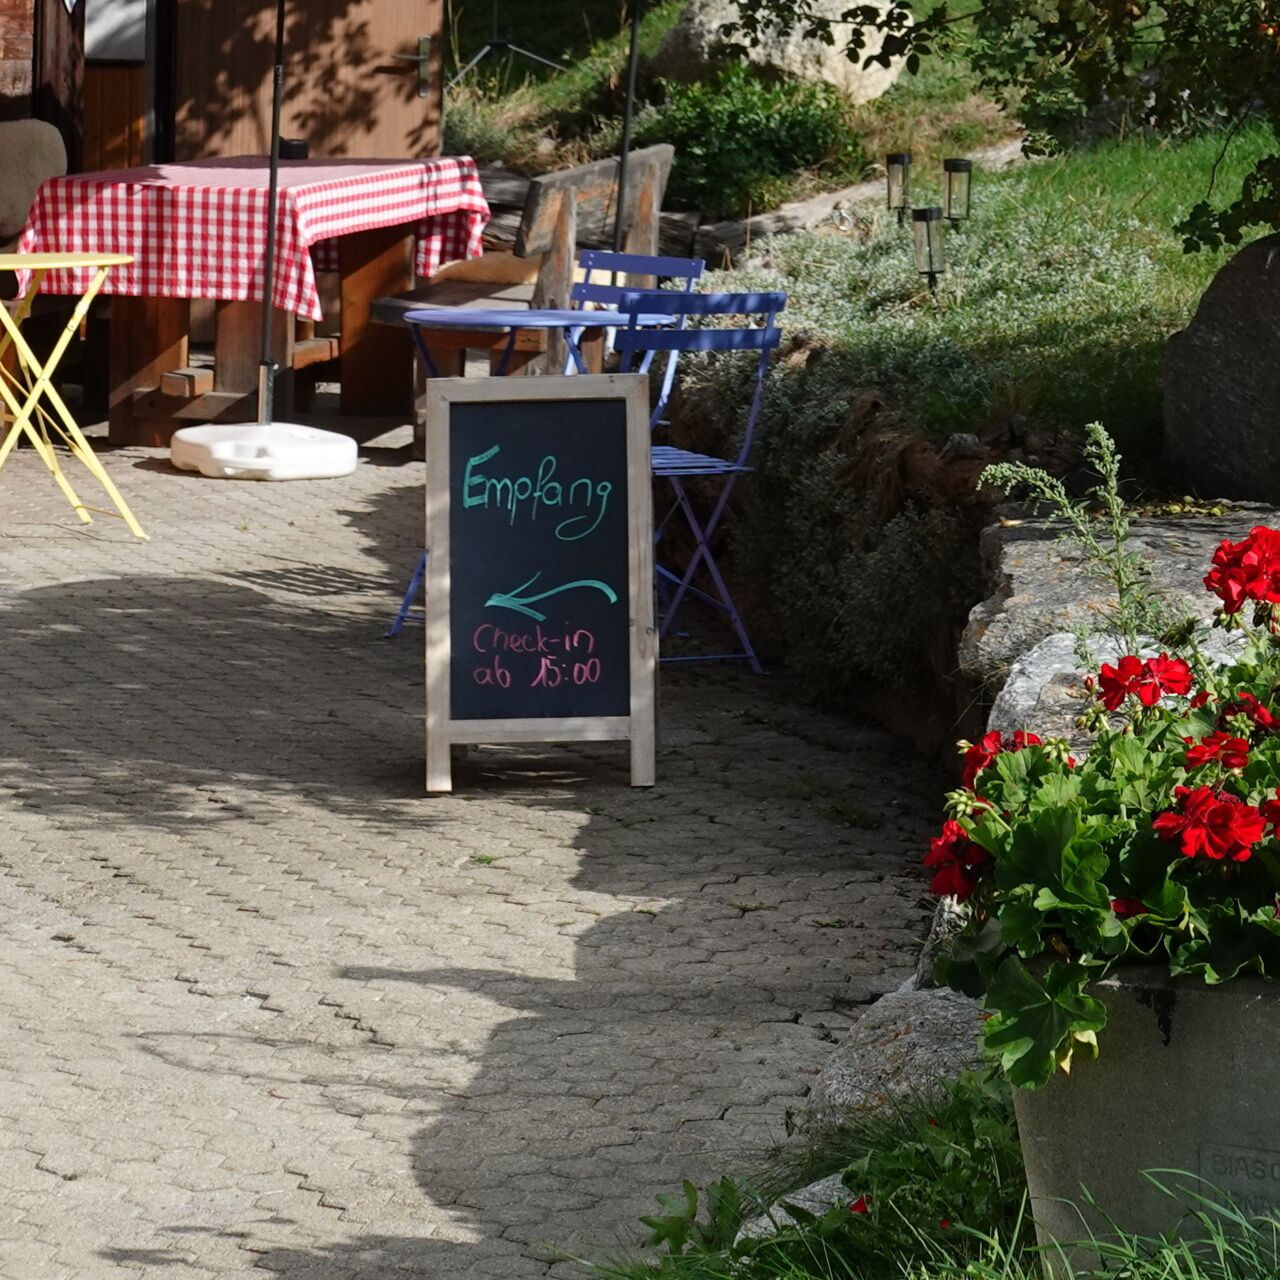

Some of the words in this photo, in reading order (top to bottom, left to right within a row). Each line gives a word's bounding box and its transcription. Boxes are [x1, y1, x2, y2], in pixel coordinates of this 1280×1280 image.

[462, 444, 612, 541] Empfang
[473, 621, 595, 654] Check-in
[473, 654, 511, 688] ab
[531, 655, 601, 688] 15:00
